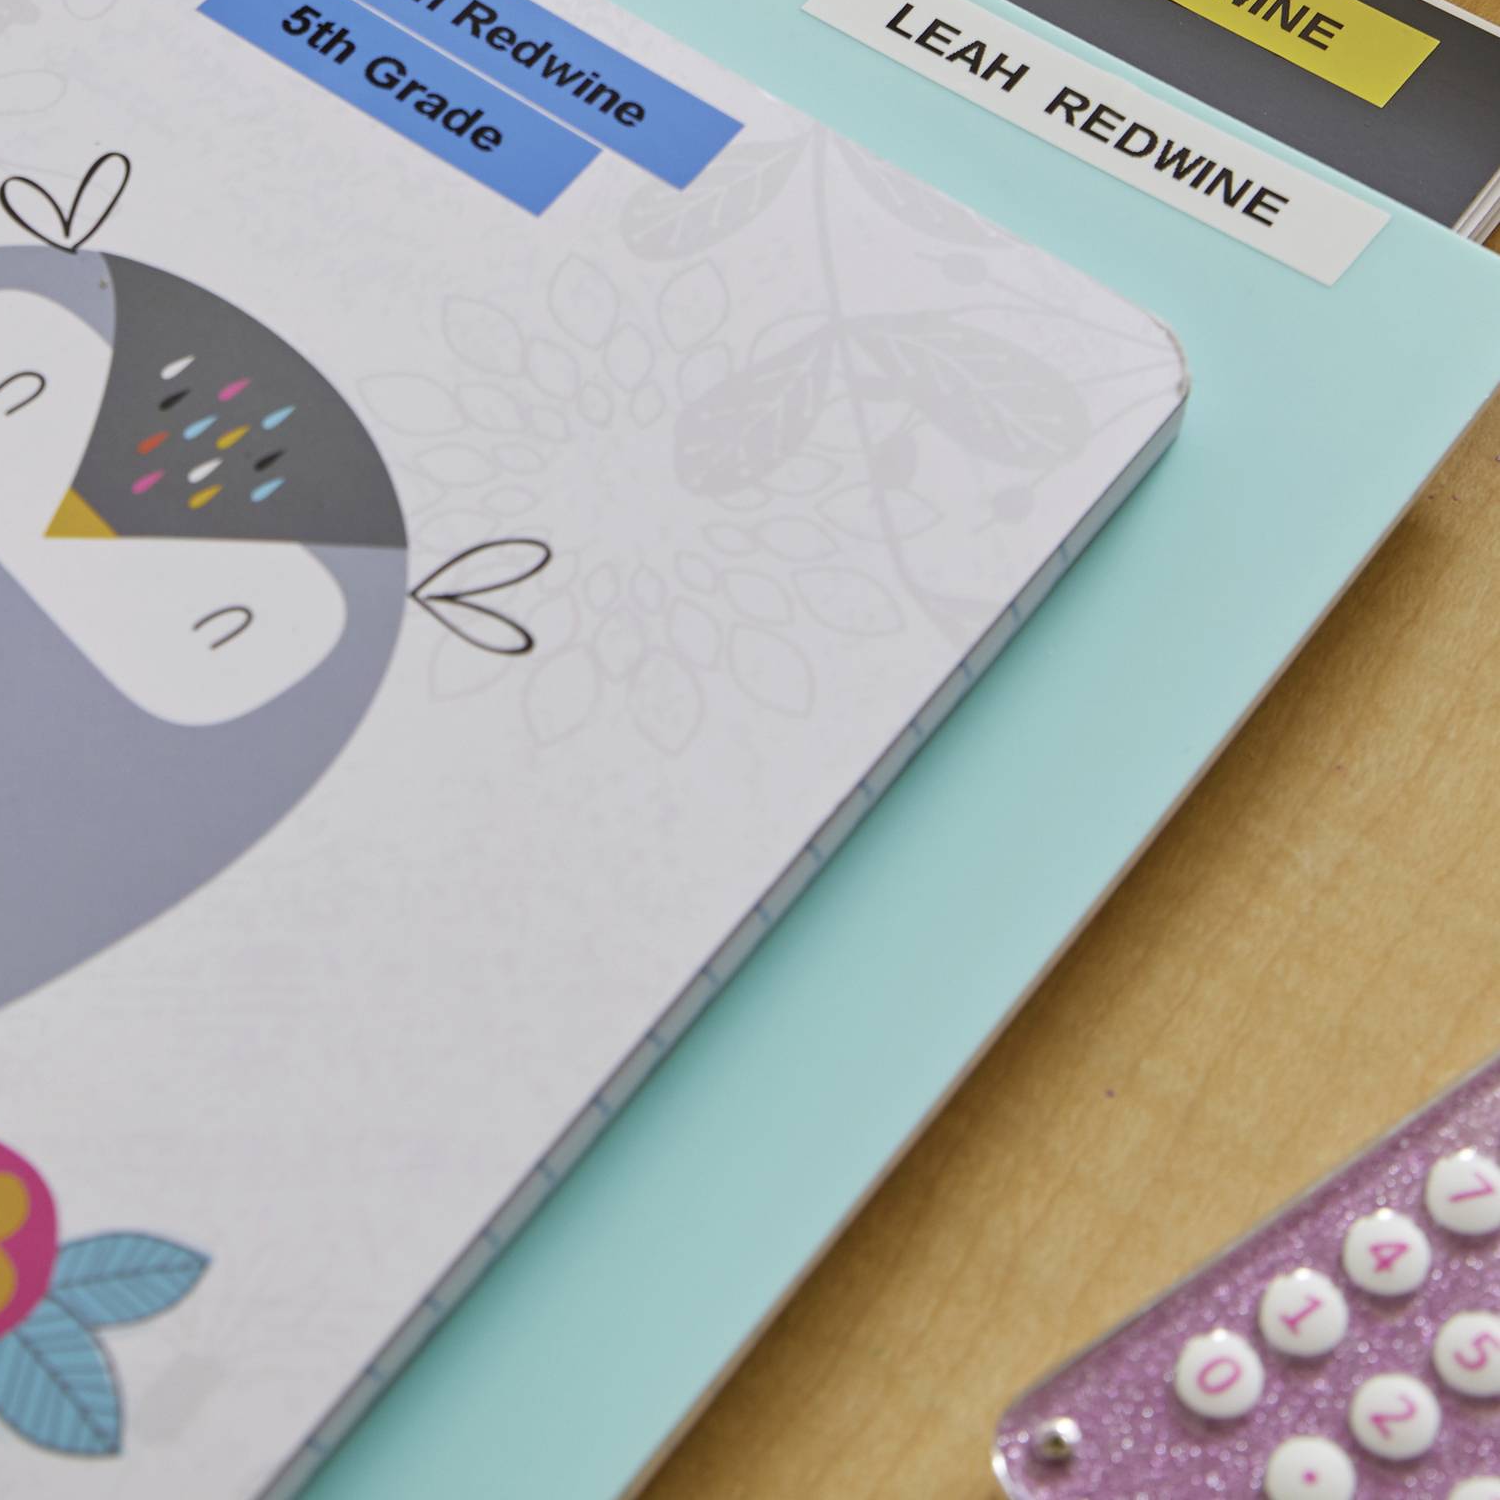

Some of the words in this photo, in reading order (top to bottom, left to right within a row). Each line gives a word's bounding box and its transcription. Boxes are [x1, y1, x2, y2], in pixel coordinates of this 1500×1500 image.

[281, 4, 357, 66] 5th
[364, 56, 504, 153] Grade
[884, 2, 1031, 93] LEAH
[1043, 85, 1290, 229] REDWINE
[1448, 1171, 1495, 1204] 7
[1368, 1240, 1411, 1274] 4
[1279, 1296, 1322, 1337] 1
[1452, 1330, 1500, 1373] 5
[1195, 1356, 1243, 1396] 0
[1368, 1393, 1418, 1439] 2
